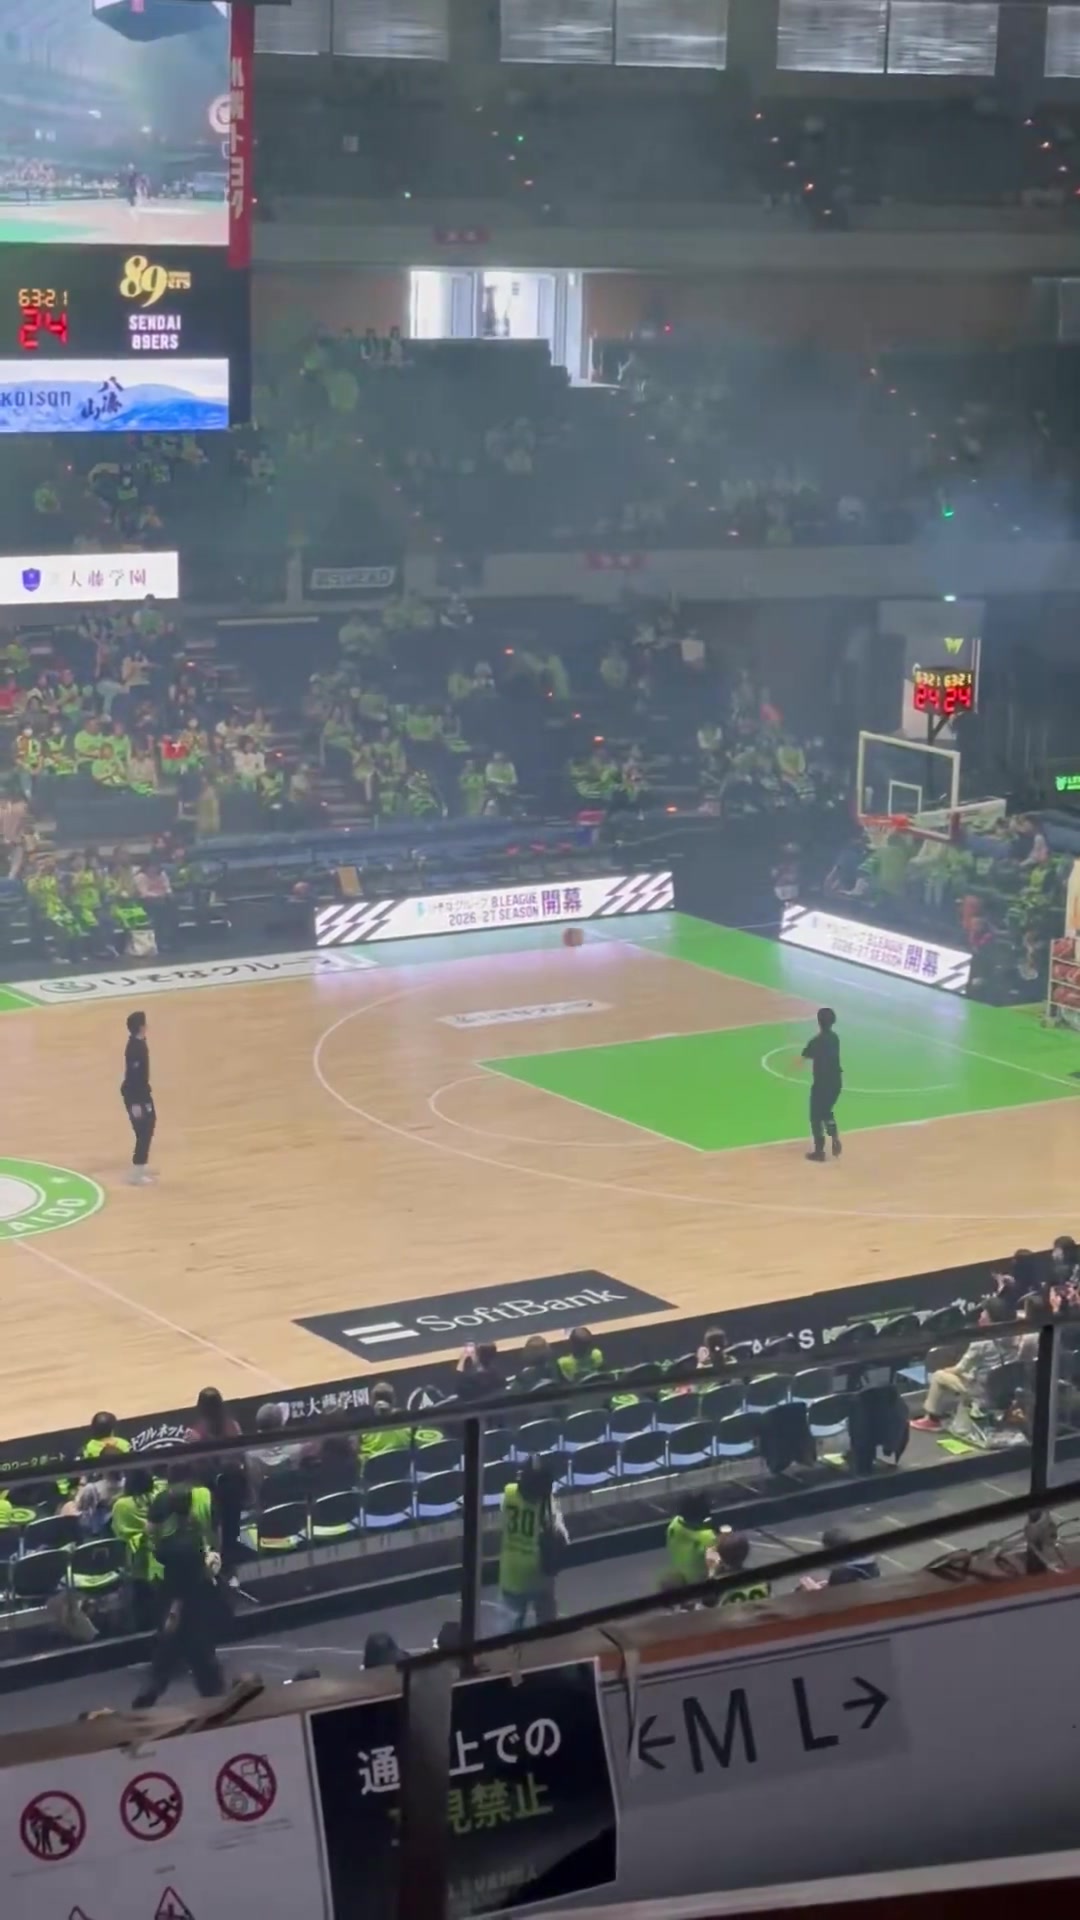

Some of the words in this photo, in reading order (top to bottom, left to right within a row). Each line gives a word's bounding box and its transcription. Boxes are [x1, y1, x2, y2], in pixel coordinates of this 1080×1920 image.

[20, 307, 67, 349] 24
[129, 315, 181, 331] SENDAI
[132, 334, 179, 350] 89ERS
[915, 685, 940, 710] 24
[944, 686, 971, 713] 24
[498, 904, 539, 921] SEASON
[541, 887, 583, 917] 開幕
[415, 1288, 628, 1332] SoftBank
[506, 1506, 535, 1538] 30
[682, 1688, 757, 1774] M
[792, 1677, 839, 1751] L
[358, 1718, 561, 1795] 通上での
